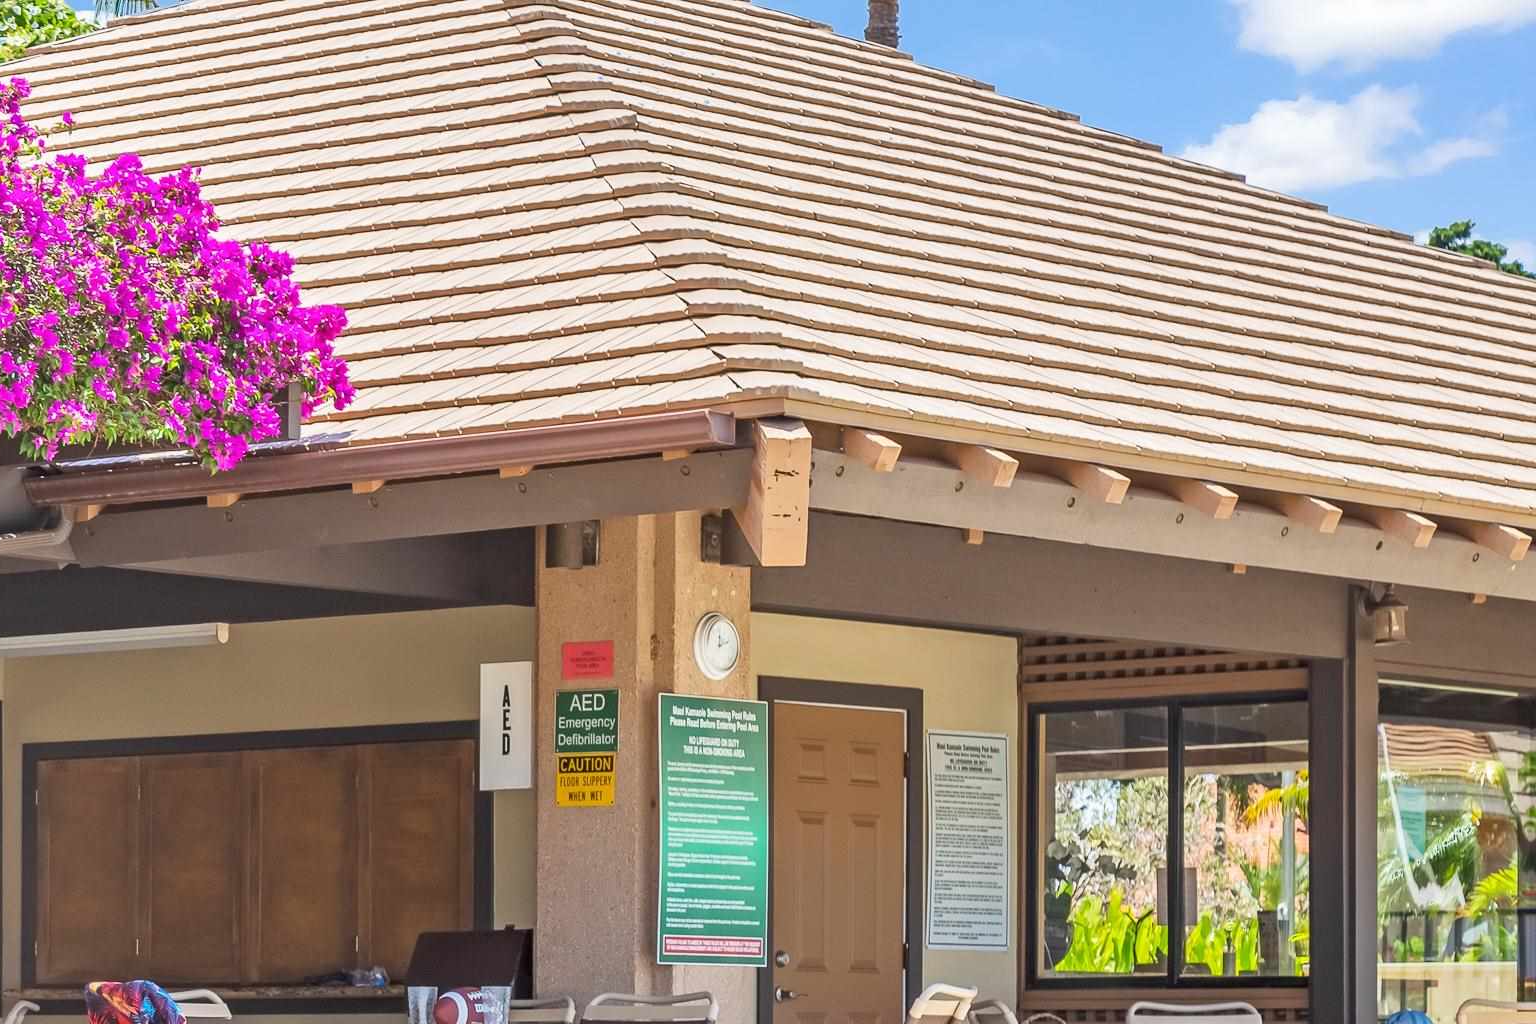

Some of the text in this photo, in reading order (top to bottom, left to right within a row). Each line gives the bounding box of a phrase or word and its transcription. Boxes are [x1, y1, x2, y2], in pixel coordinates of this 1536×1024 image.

[569, 693, 606, 712] AED
[502, 684, 512, 756] AED
[558, 716, 616, 731] Emergency
[558, 733, 616, 746] Defibrillator
[560, 757, 612, 772] CAUTION
[560, 775, 612, 787] FLOOR SLIPPERY
[568, 791, 604, 801] WHEN WET
